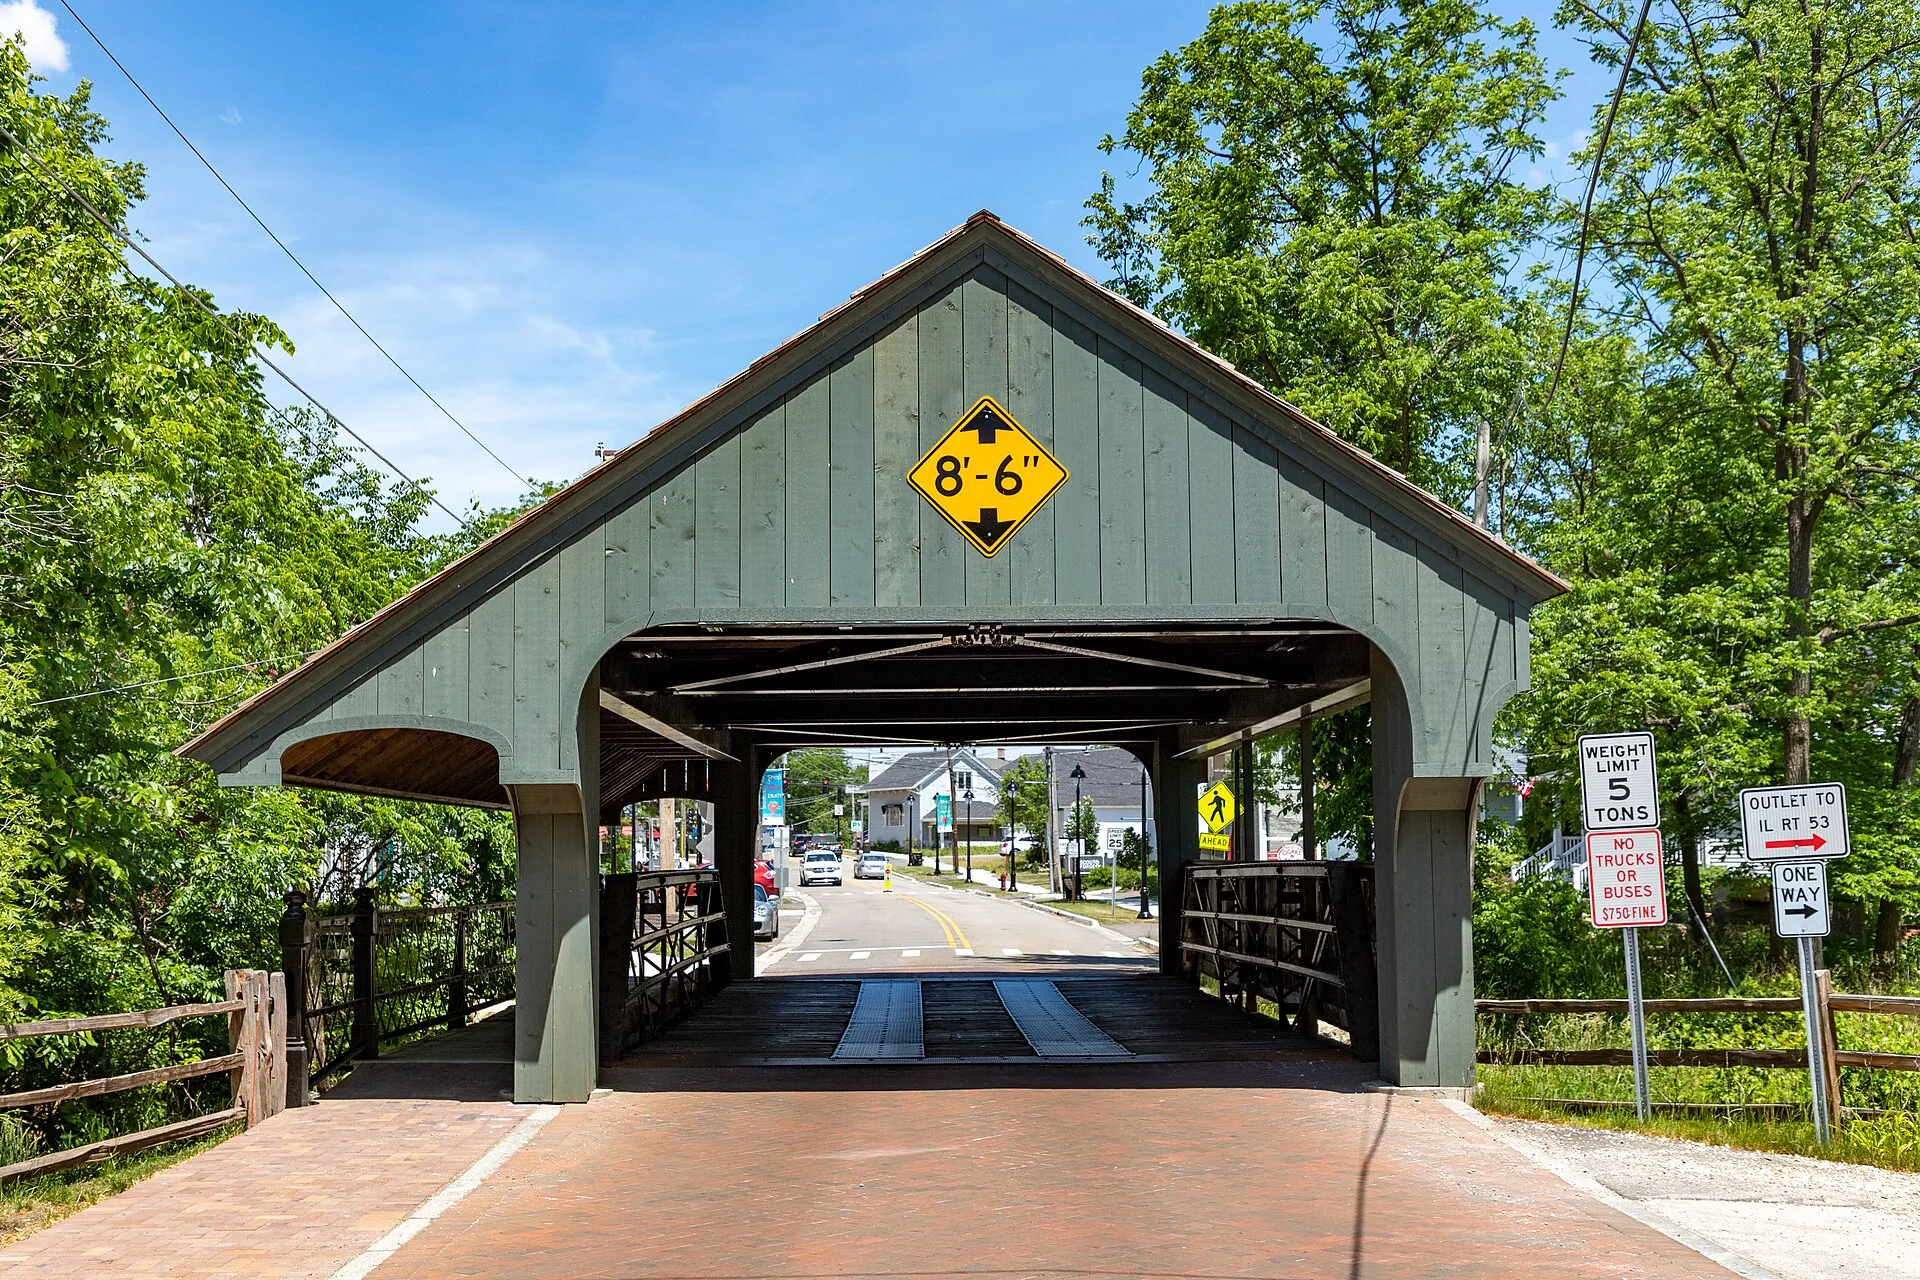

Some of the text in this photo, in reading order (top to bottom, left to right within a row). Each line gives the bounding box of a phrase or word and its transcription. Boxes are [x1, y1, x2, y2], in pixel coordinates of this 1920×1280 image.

[1585, 743, 1648, 759] WEIGHT
[1597, 759, 1640, 773] LIMIT
[1608, 777, 1631, 801] 5
[1750, 792, 1835, 810] OUTLET TO
[1595, 806, 1649, 822] TONS
[1759, 815, 1830, 833] IL RT 53
[1109, 839, 1122, 847] 25
[1202, 837, 1227, 846] AHEAD
[1614, 838, 1634, 850] NO
[1596, 853, 1655, 867] TRUCKS
[1617, 870, 1637, 882] OR
[1782, 867, 1817, 882] ONE
[1604, 885, 1652, 899] BUSES
[1781, 887, 1820, 903] WAY
[1602, 906, 1656, 921] $750 FINE
